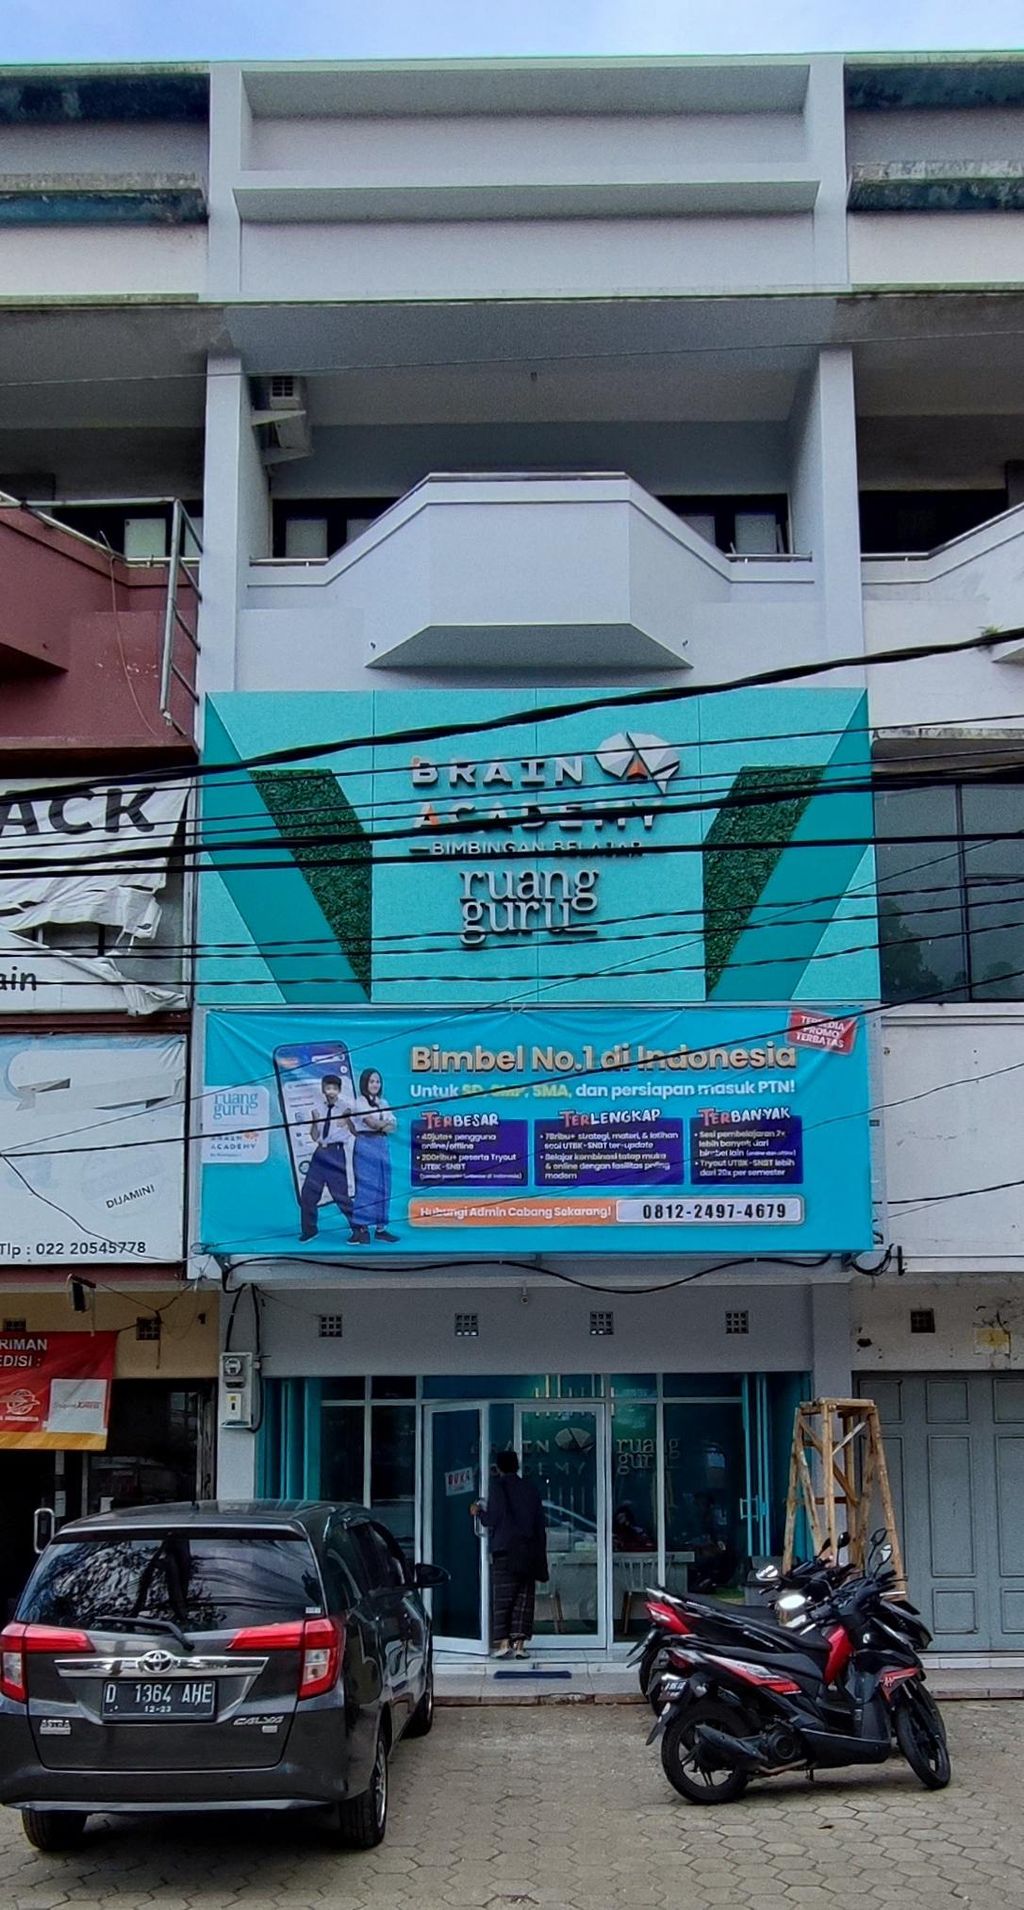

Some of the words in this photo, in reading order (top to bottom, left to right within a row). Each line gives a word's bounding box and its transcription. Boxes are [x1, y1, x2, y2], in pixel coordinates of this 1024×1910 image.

[411, 757, 584, 785] BRAIN
[0, 787, 157, 836] ACK
[430, 842, 544, 855] BIMBINGAN
[460, 869, 599, 912] ruang
[459, 900, 572, 945] guru
[796, 1031, 844, 1048] TERBATAS
[803, 1025, 839, 1038] PROMO
[411, 1044, 524, 1073] Bimbel
[532, 1045, 595, 1073] No.1
[601, 1042, 630, 1071] di
[637, 1041, 796, 1071] Indonesia
[410, 1084, 459, 1099] Untuk
[533, 1083, 572, 1099] SMA,
[575, 1082, 609, 1098] dan
[611, 1082, 695, 1100] persiapan
[698, 1081, 755, 1095] masuk
[758, 1079, 796, 1094] PTN!
[214, 1092, 258, 1109] ruang
[213, 1103, 249, 1120] guru
[560, 1108, 661, 1128] TERLENGKAP
[699, 1107, 790, 1127] TERBANYAK
[421, 1111, 499, 1129] TERBESAR
[454, 1133, 497, 1143] pengguna
[649, 1131, 679, 1140] latihan
[699, 1130, 716, 1138] Sesi
[698, 1139, 719, 1147] lebih
[458, 1153, 490, 1162] peserta
[490, 1153, 517, 1162] Tryout
[618, 1152, 641, 1162] tatap
[729, 1149, 745, 1157] lain
[552, 1162, 578, 1170] online
[579, 1162, 612, 1172] dengan
[699, 1159, 727, 1168] Tryout
[774, 1158, 796, 1167] lebih
[699, 1168, 717, 1177] dari
[732, 1169, 747, 1178] per
[747, 1168, 786, 1177] semester
[469, 1206, 506, 1217] Admin
[508, 1206, 553, 1219] Cabang
[553, 1206, 611, 1219] Sekarang!
[642, 1203, 787, 1219] 0812-2497-4679
[0, 1243, 22, 1259] Tlp
[36, 1243, 64, 1255] 022
[70, 1241, 146, 1255] 20545778
[0, 1338, 48, 1351] RIMAN
[616, 1438, 680, 1460] ruag
[105, 1683, 117, 1703] D
[135, 1683, 172, 1703] 1364
[181, 1683, 213, 1704] AHE
